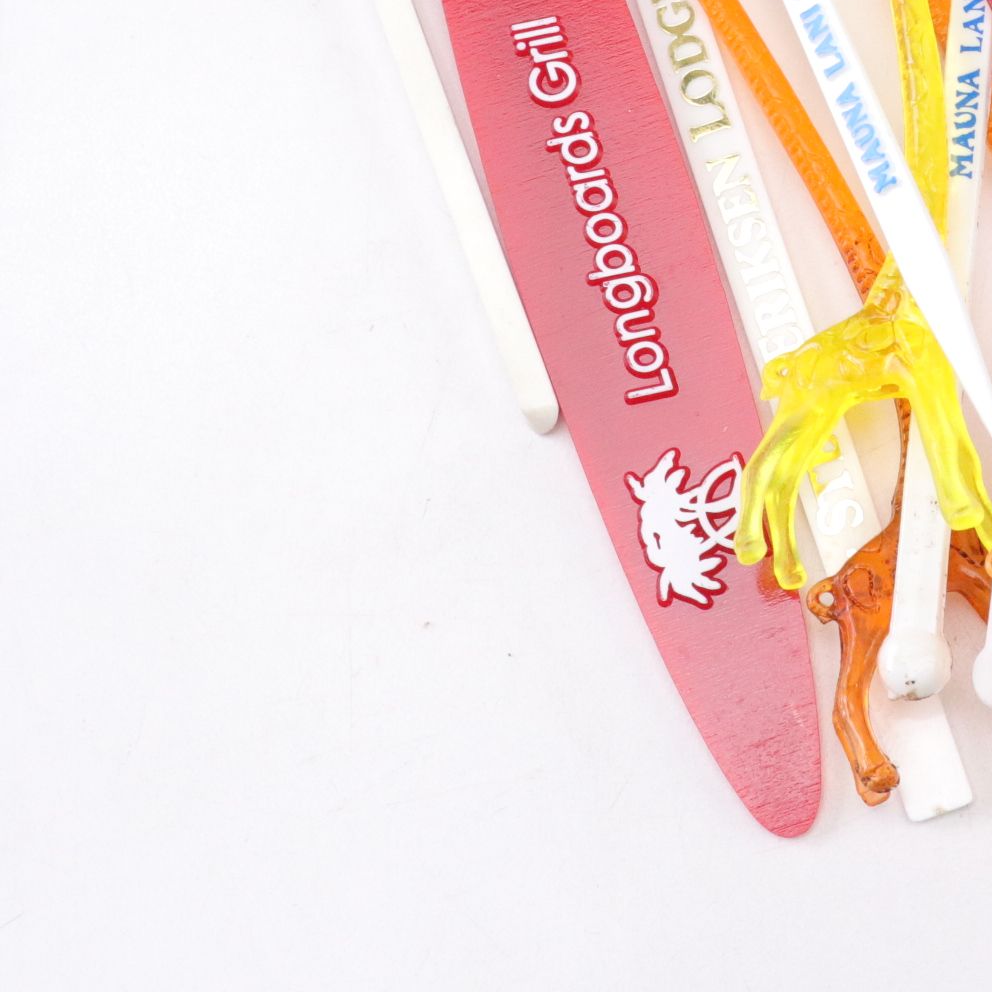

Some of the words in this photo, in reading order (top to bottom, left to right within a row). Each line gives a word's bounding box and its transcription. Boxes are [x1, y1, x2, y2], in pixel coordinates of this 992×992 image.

[511, 15, 578, 104] Grill
[800, 4, 850, 80] LANI
[836, 83, 898, 194] MAUNA
[948, 68, 981, 179] MAUNA
[547, 111, 677, 403] Longboards
[705, 153, 801, 356] ERIKSEN
